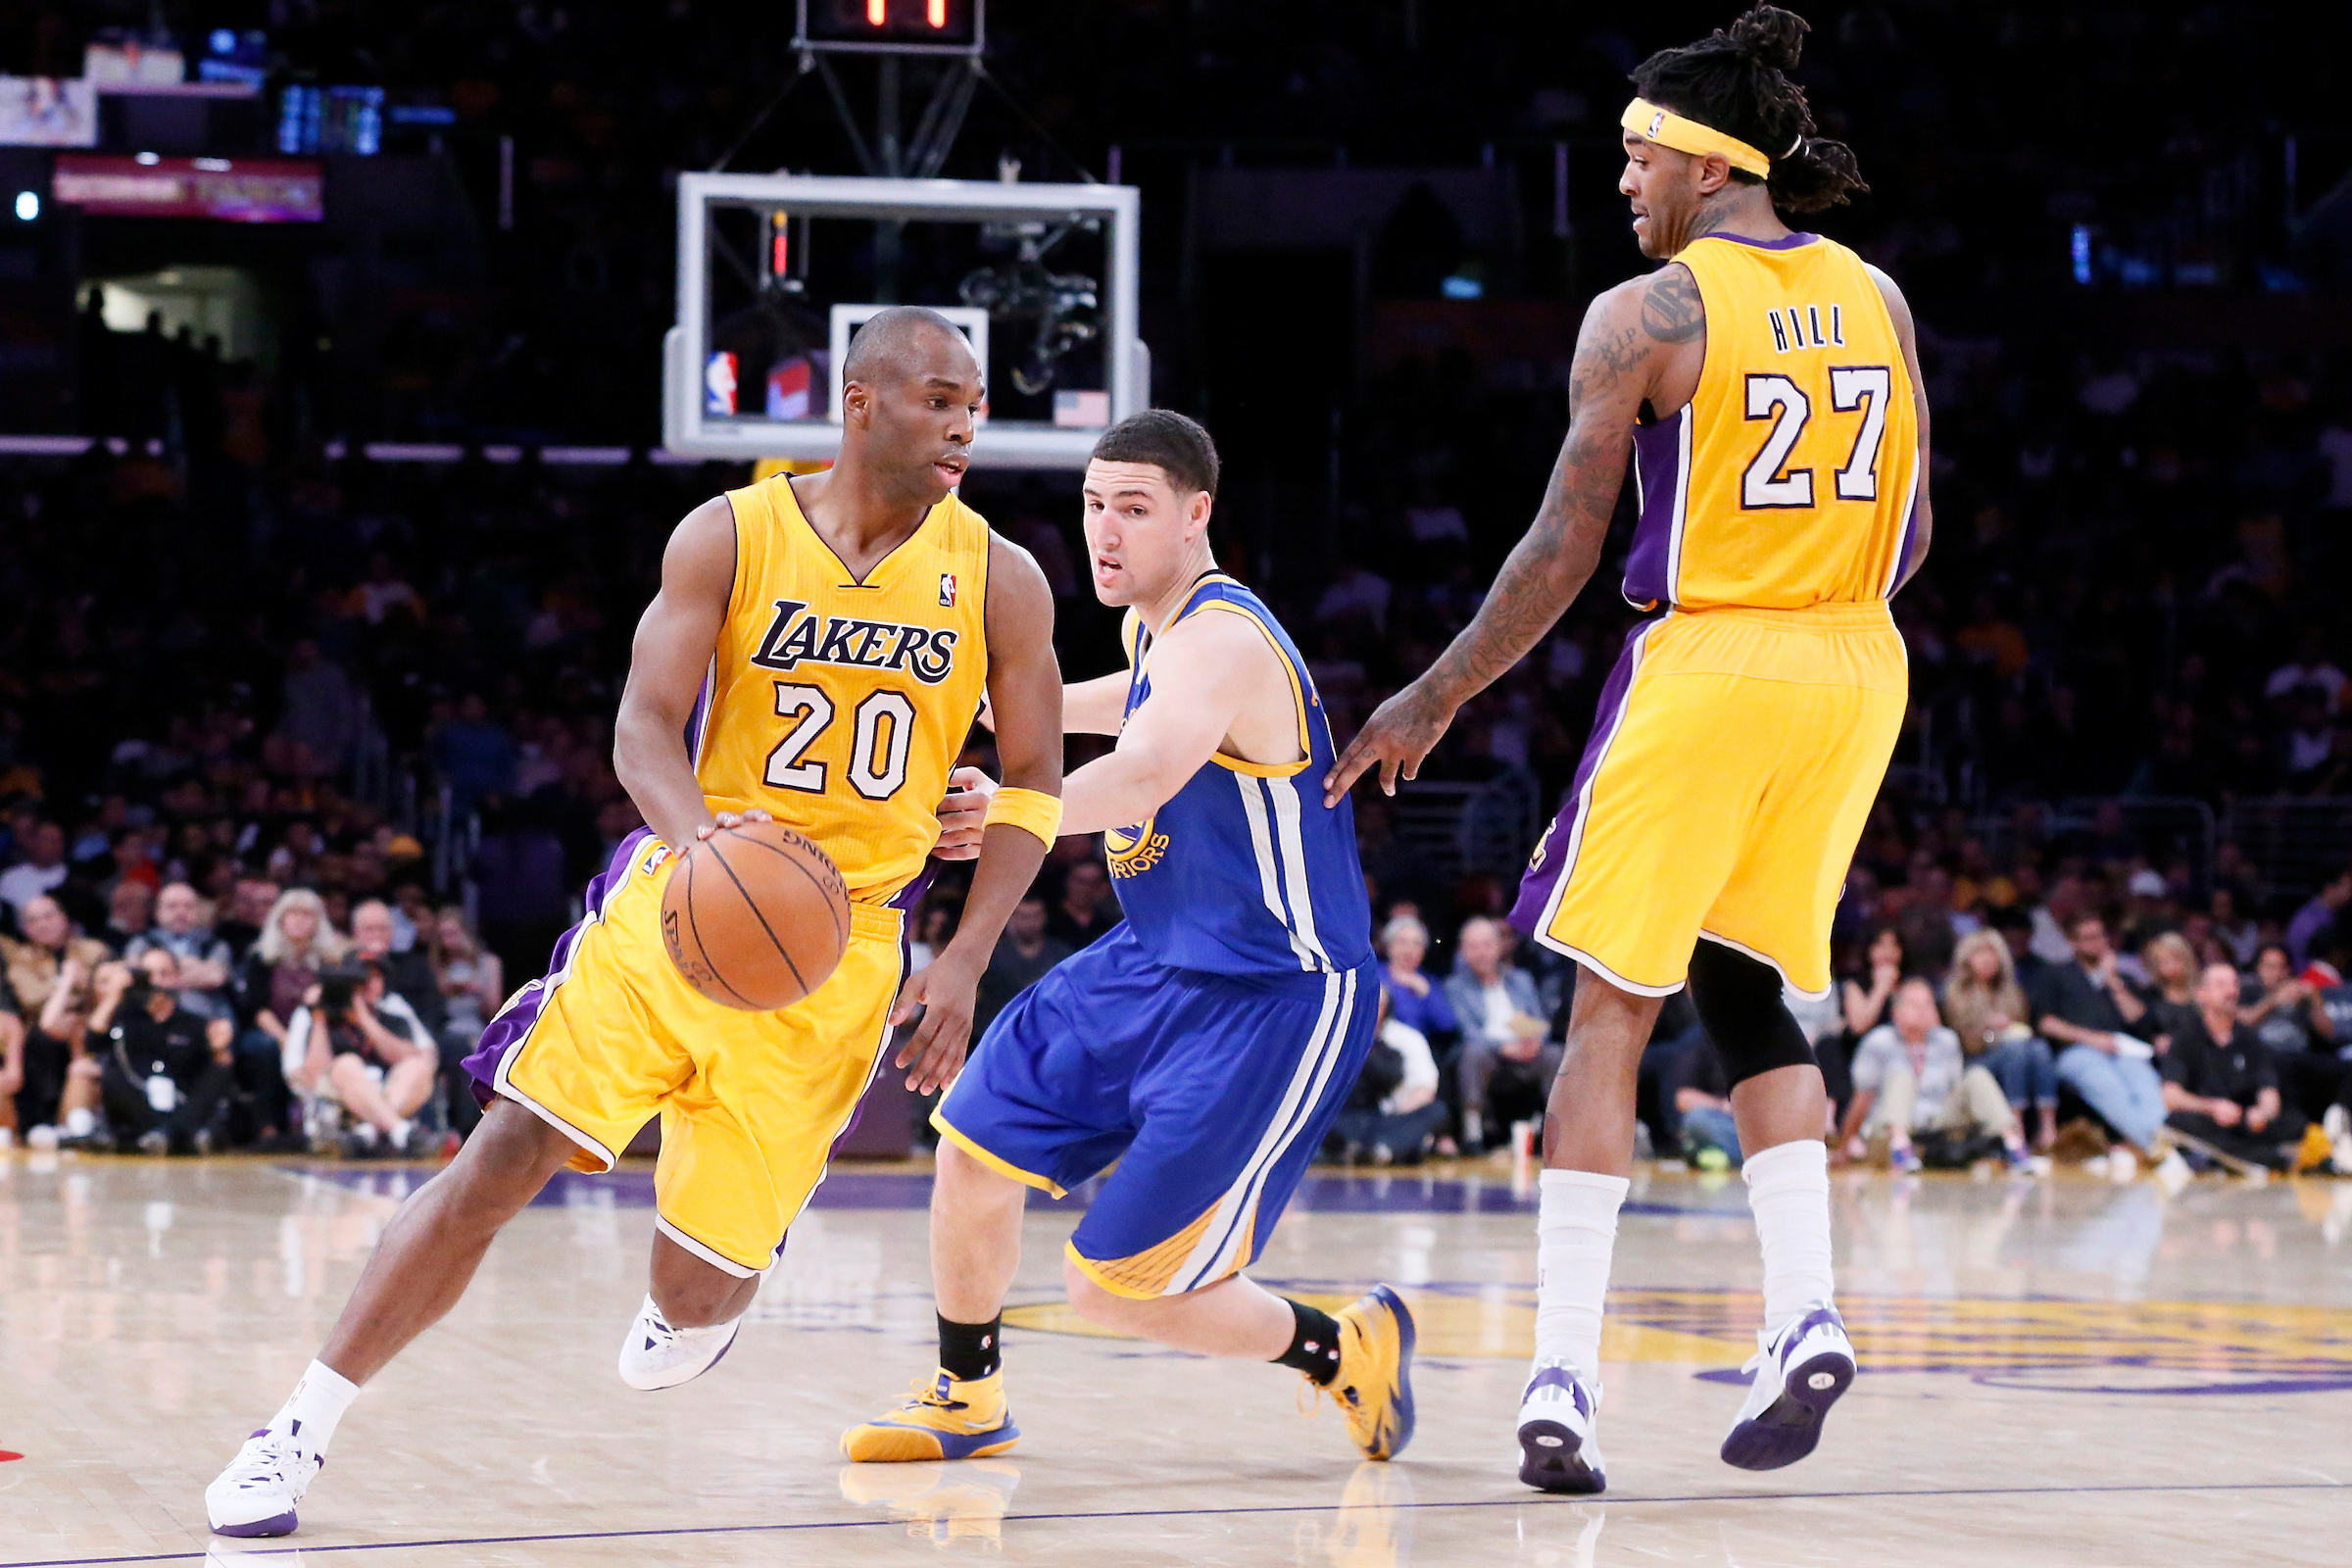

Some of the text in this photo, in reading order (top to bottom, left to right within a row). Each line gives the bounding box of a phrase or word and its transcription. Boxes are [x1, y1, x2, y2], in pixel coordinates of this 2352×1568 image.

[1766, 304, 1846, 354] HILL
[1740, 366, 1890, 510] 27
[751, 599, 959, 685] LAKERS
[762, 680, 917, 802] 20
[1109, 832, 1170, 879] RIORS
